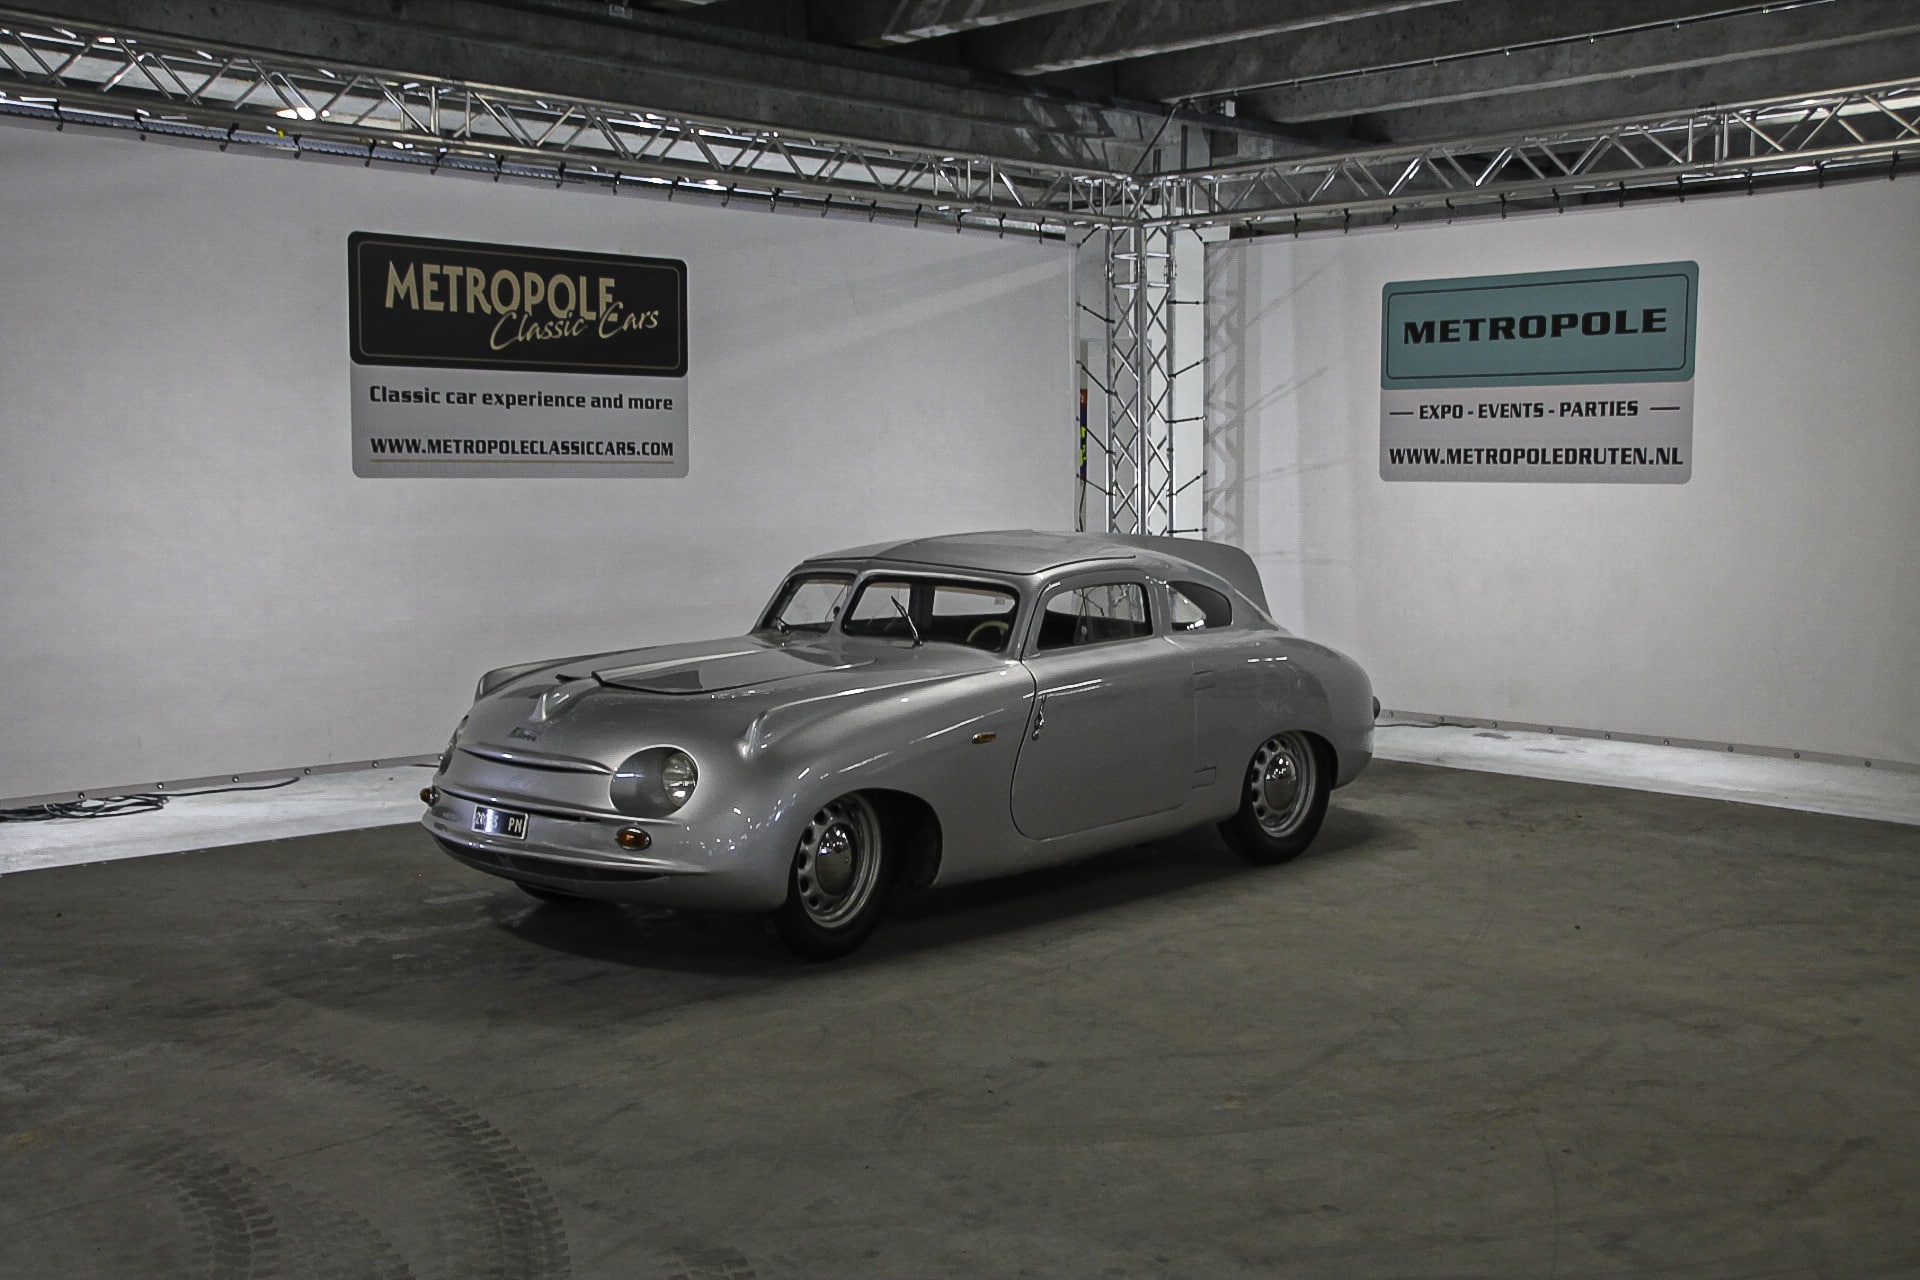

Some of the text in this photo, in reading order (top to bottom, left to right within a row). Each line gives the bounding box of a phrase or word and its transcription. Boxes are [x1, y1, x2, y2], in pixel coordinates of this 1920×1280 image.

[385, 261, 618, 321] METROPOLE
[490, 302, 659, 350] Classic Cars
[1403, 308, 1667, 344] METROPOLE
[369, 386, 673, 410] Classic car experience and more
[1419, 404, 1464, 419] EXPO
[1478, 402, 1544, 419] EVENTS
[1559, 400, 1639, 417] PARTIES
[370, 438, 674, 456] WWW.METROPOLECLASSICCARS.COM
[1389, 447, 1683, 465] WWW.METROPOLEDRUTEN.NL
[508, 817, 523, 833] PN
